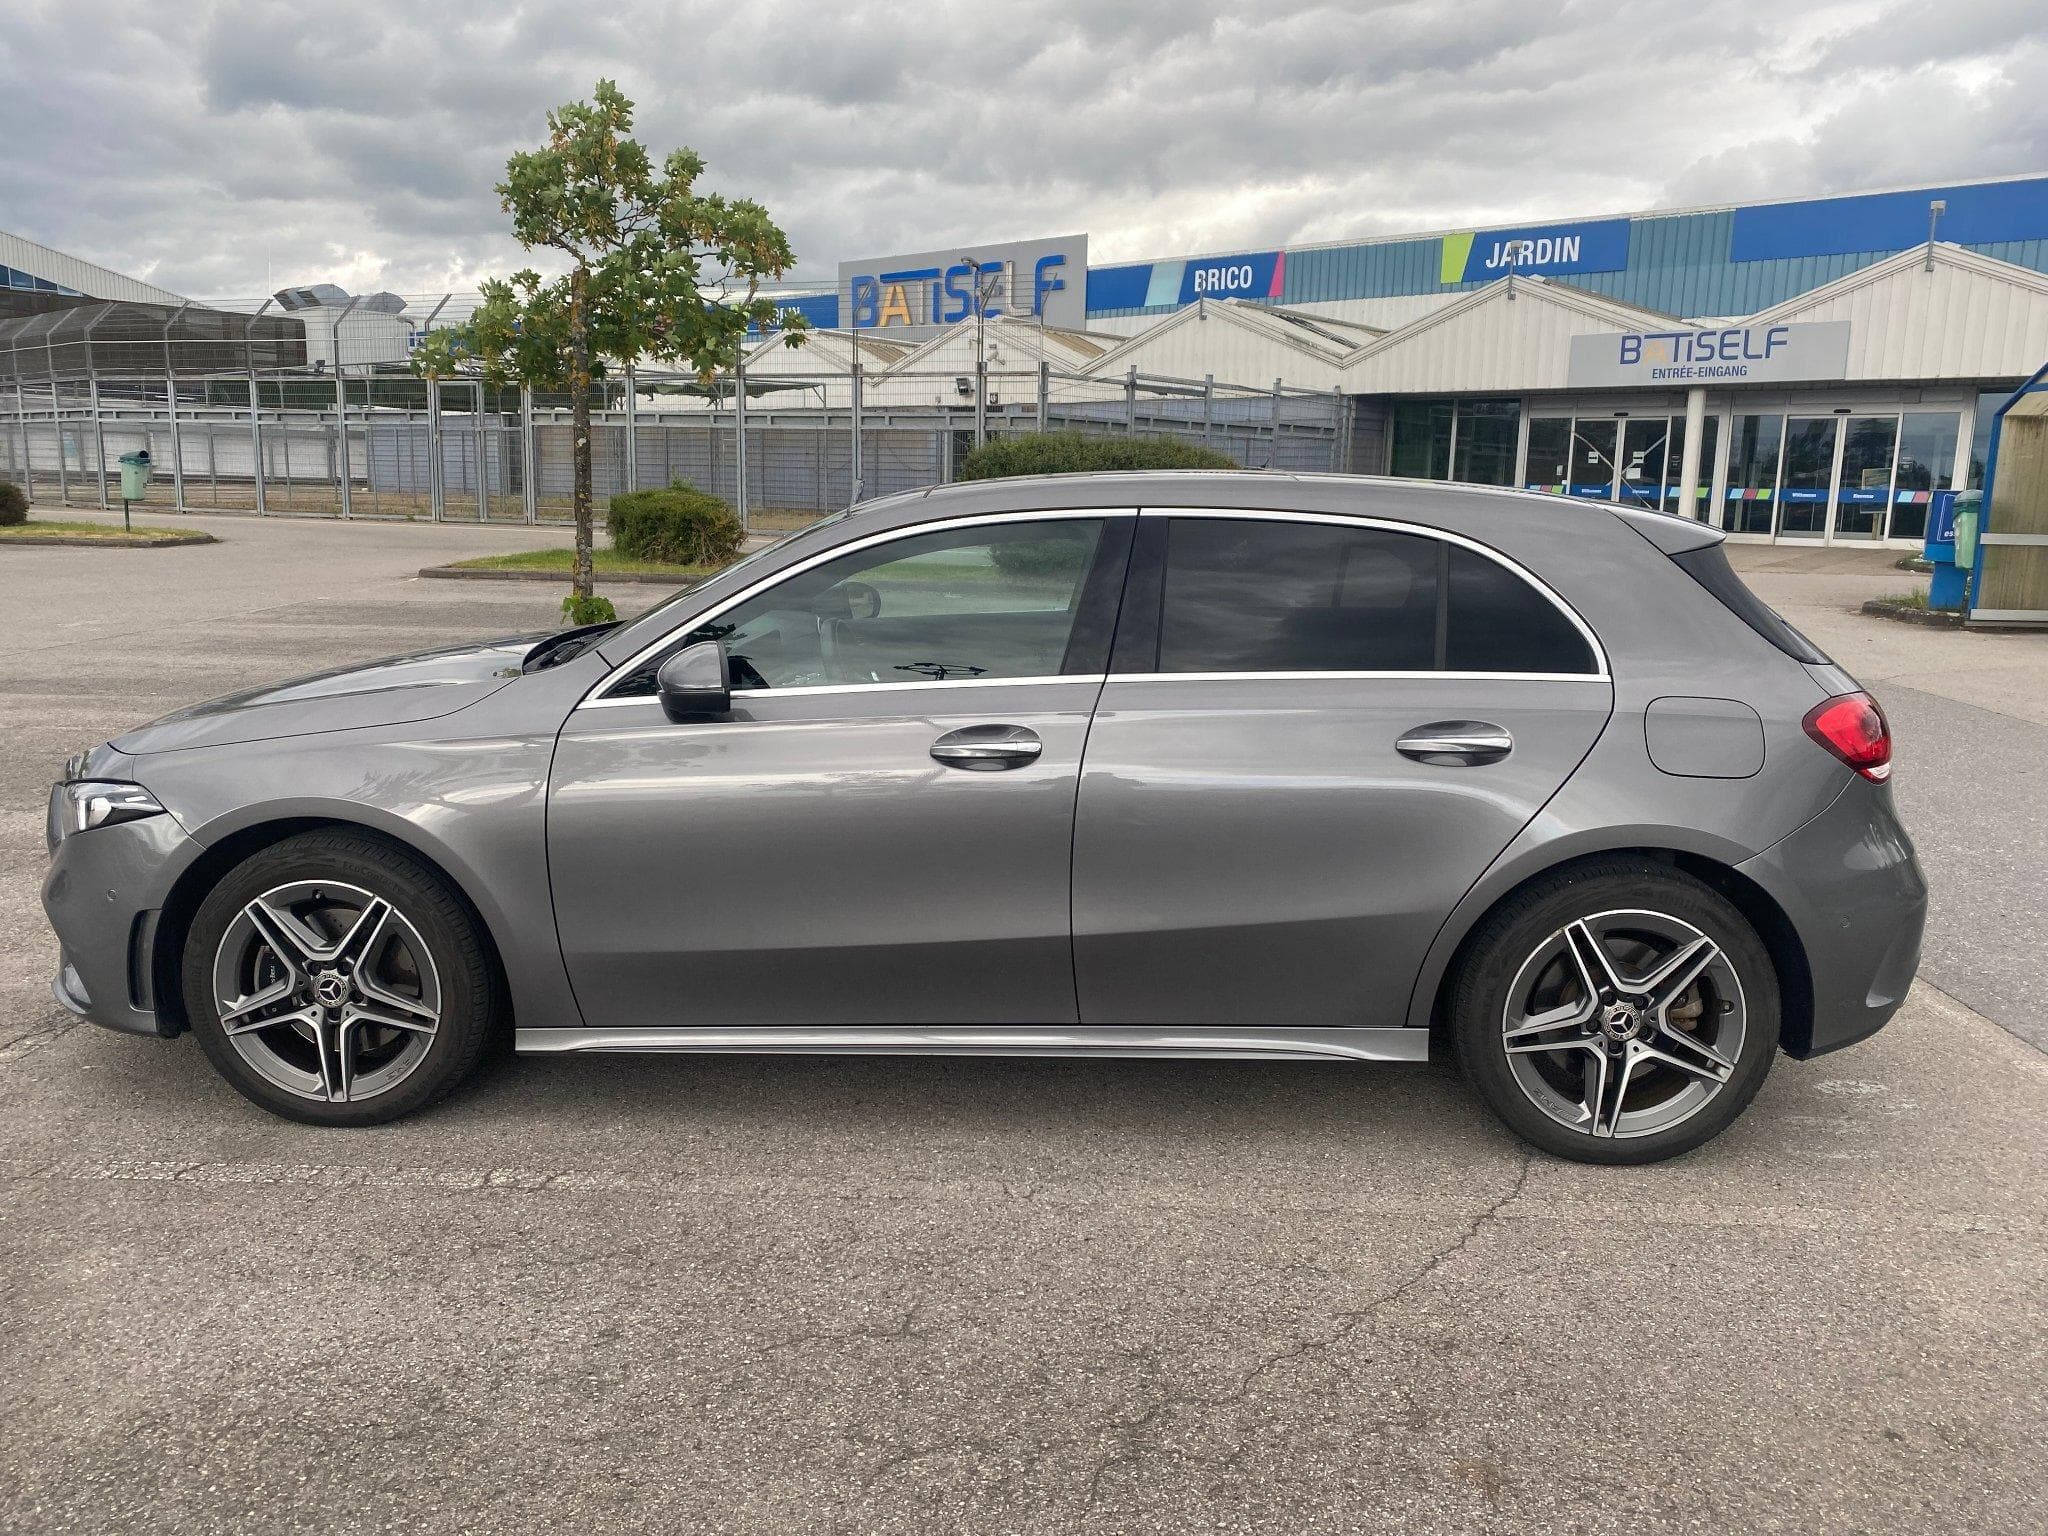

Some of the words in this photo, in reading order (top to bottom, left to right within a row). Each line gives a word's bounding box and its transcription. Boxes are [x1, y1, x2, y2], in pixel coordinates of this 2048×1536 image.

[1485, 236, 1581, 268] JARDIN
[1194, 265, 1253, 292] BRICO
[1651, 364, 1748, 380] ENTRÉE-EINGANG
